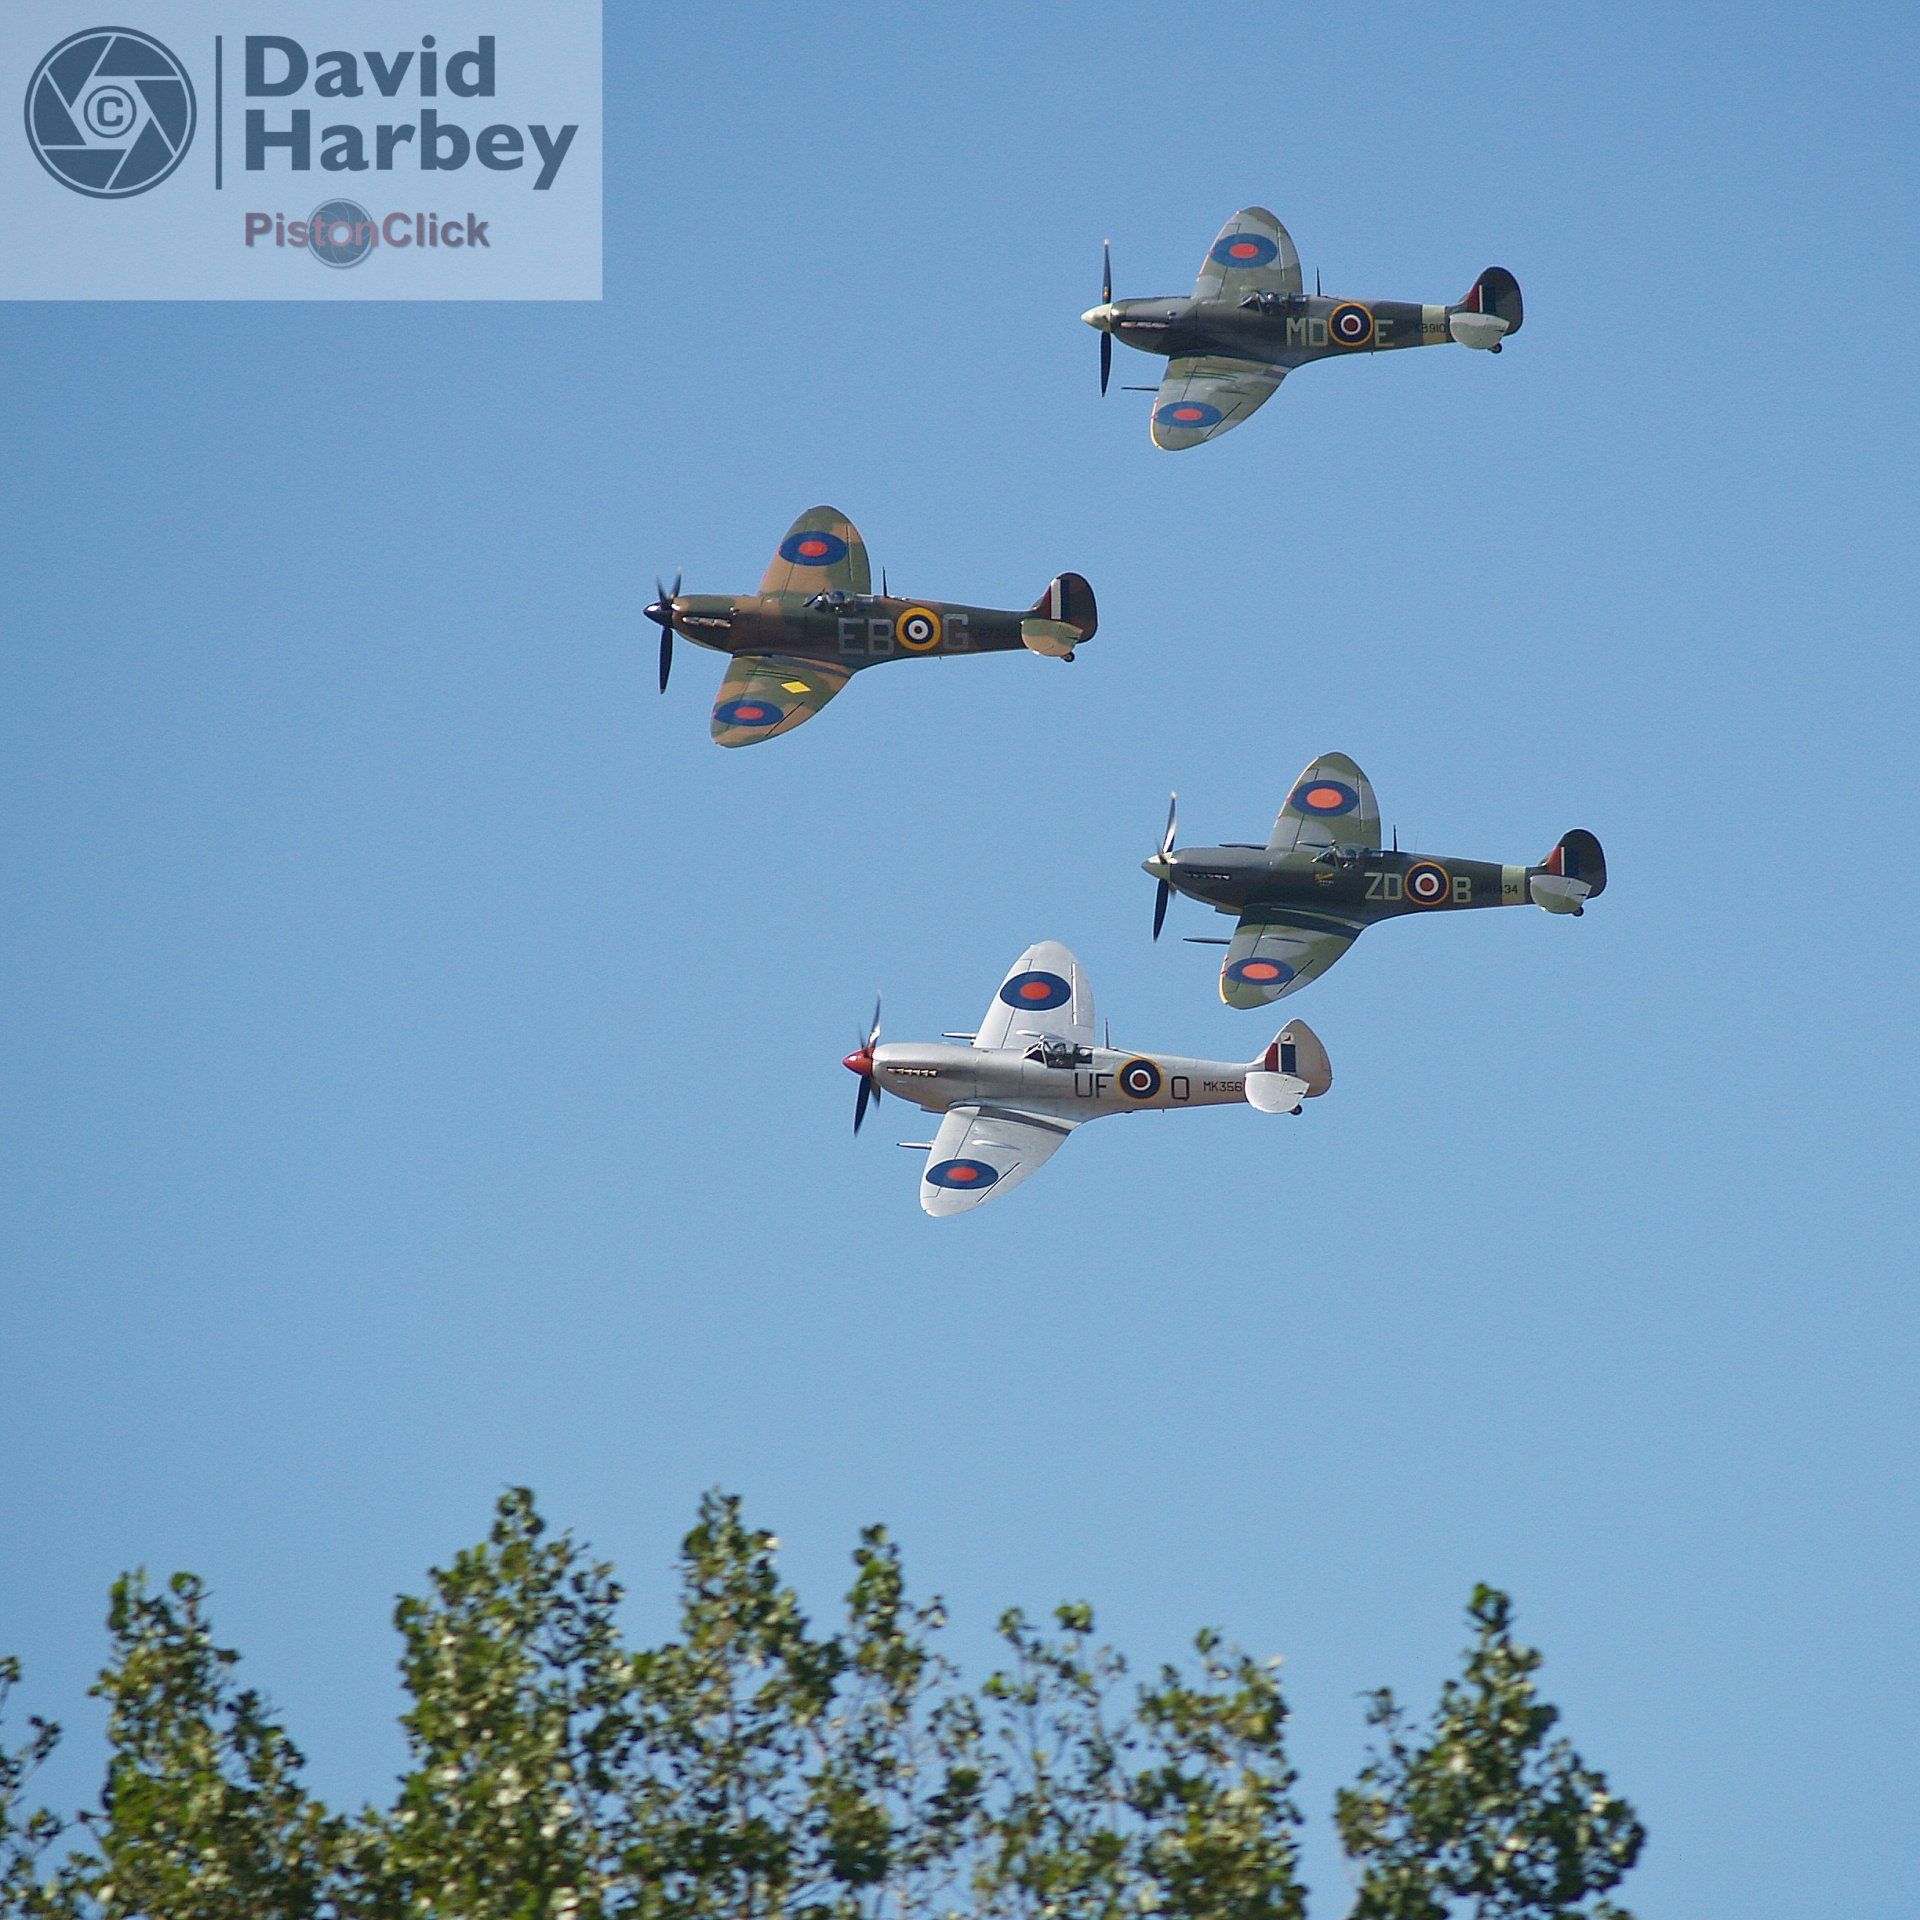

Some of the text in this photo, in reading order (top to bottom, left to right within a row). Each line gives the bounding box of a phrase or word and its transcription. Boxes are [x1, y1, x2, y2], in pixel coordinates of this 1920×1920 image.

[1286, 317, 1396, 348] MD E
[1414, 322, 1446, 334] B910
[838, 613, 969, 655] EB G
[1363, 872, 1472, 903] ZD B
[1074, 1072, 1114, 1098] UF
[1203, 1081, 1243, 1092] MK356
